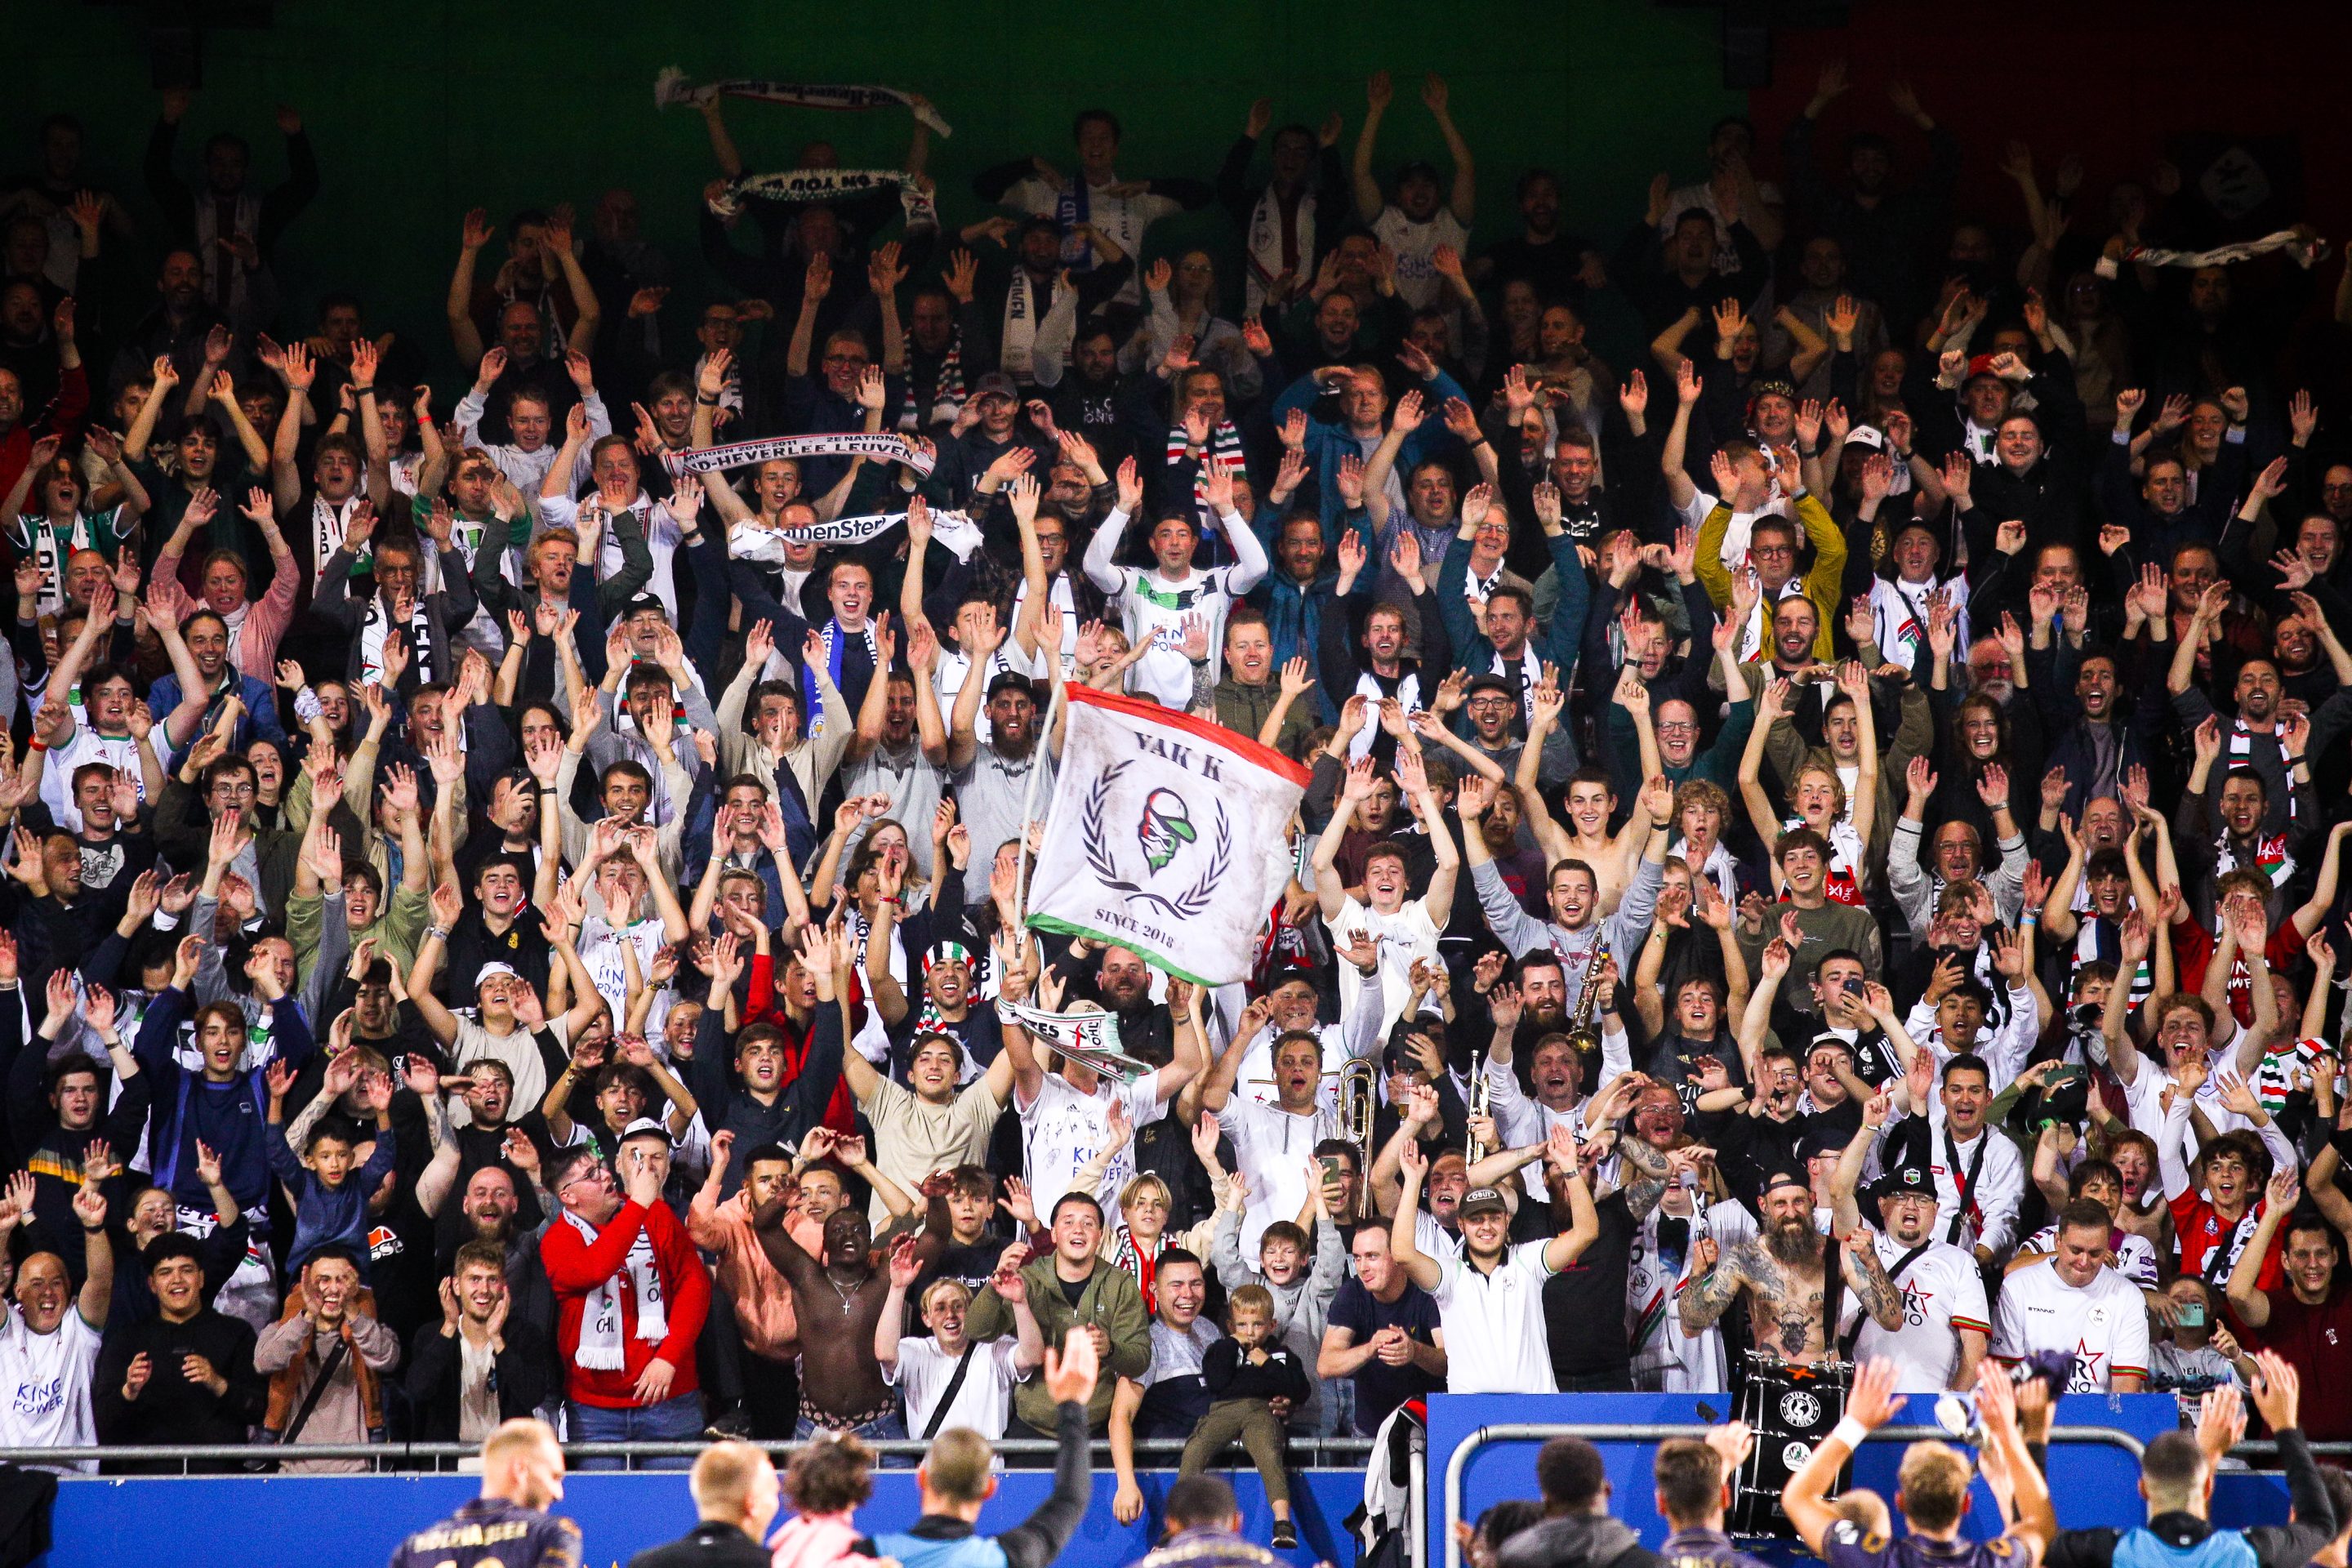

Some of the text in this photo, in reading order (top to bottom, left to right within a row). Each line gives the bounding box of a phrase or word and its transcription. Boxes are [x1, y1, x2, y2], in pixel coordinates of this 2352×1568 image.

[693, 443, 914, 471] D-HEVERLEE LEUVEN
[743, 439, 798, 457] 2010-2011
[844, 433, 903, 445] NATIONA
[1134, 730, 1223, 783] YAK K
[1842, 886, 1855, 902] OHL
[1095, 907, 1175, 949] SINCE 2018
[1088, 1019, 1102, 1047] OHL
[596, 1316, 615, 1334] OHL
[16, 1378, 63, 1402] KING
[13, 1396, 65, 1415] POWER
